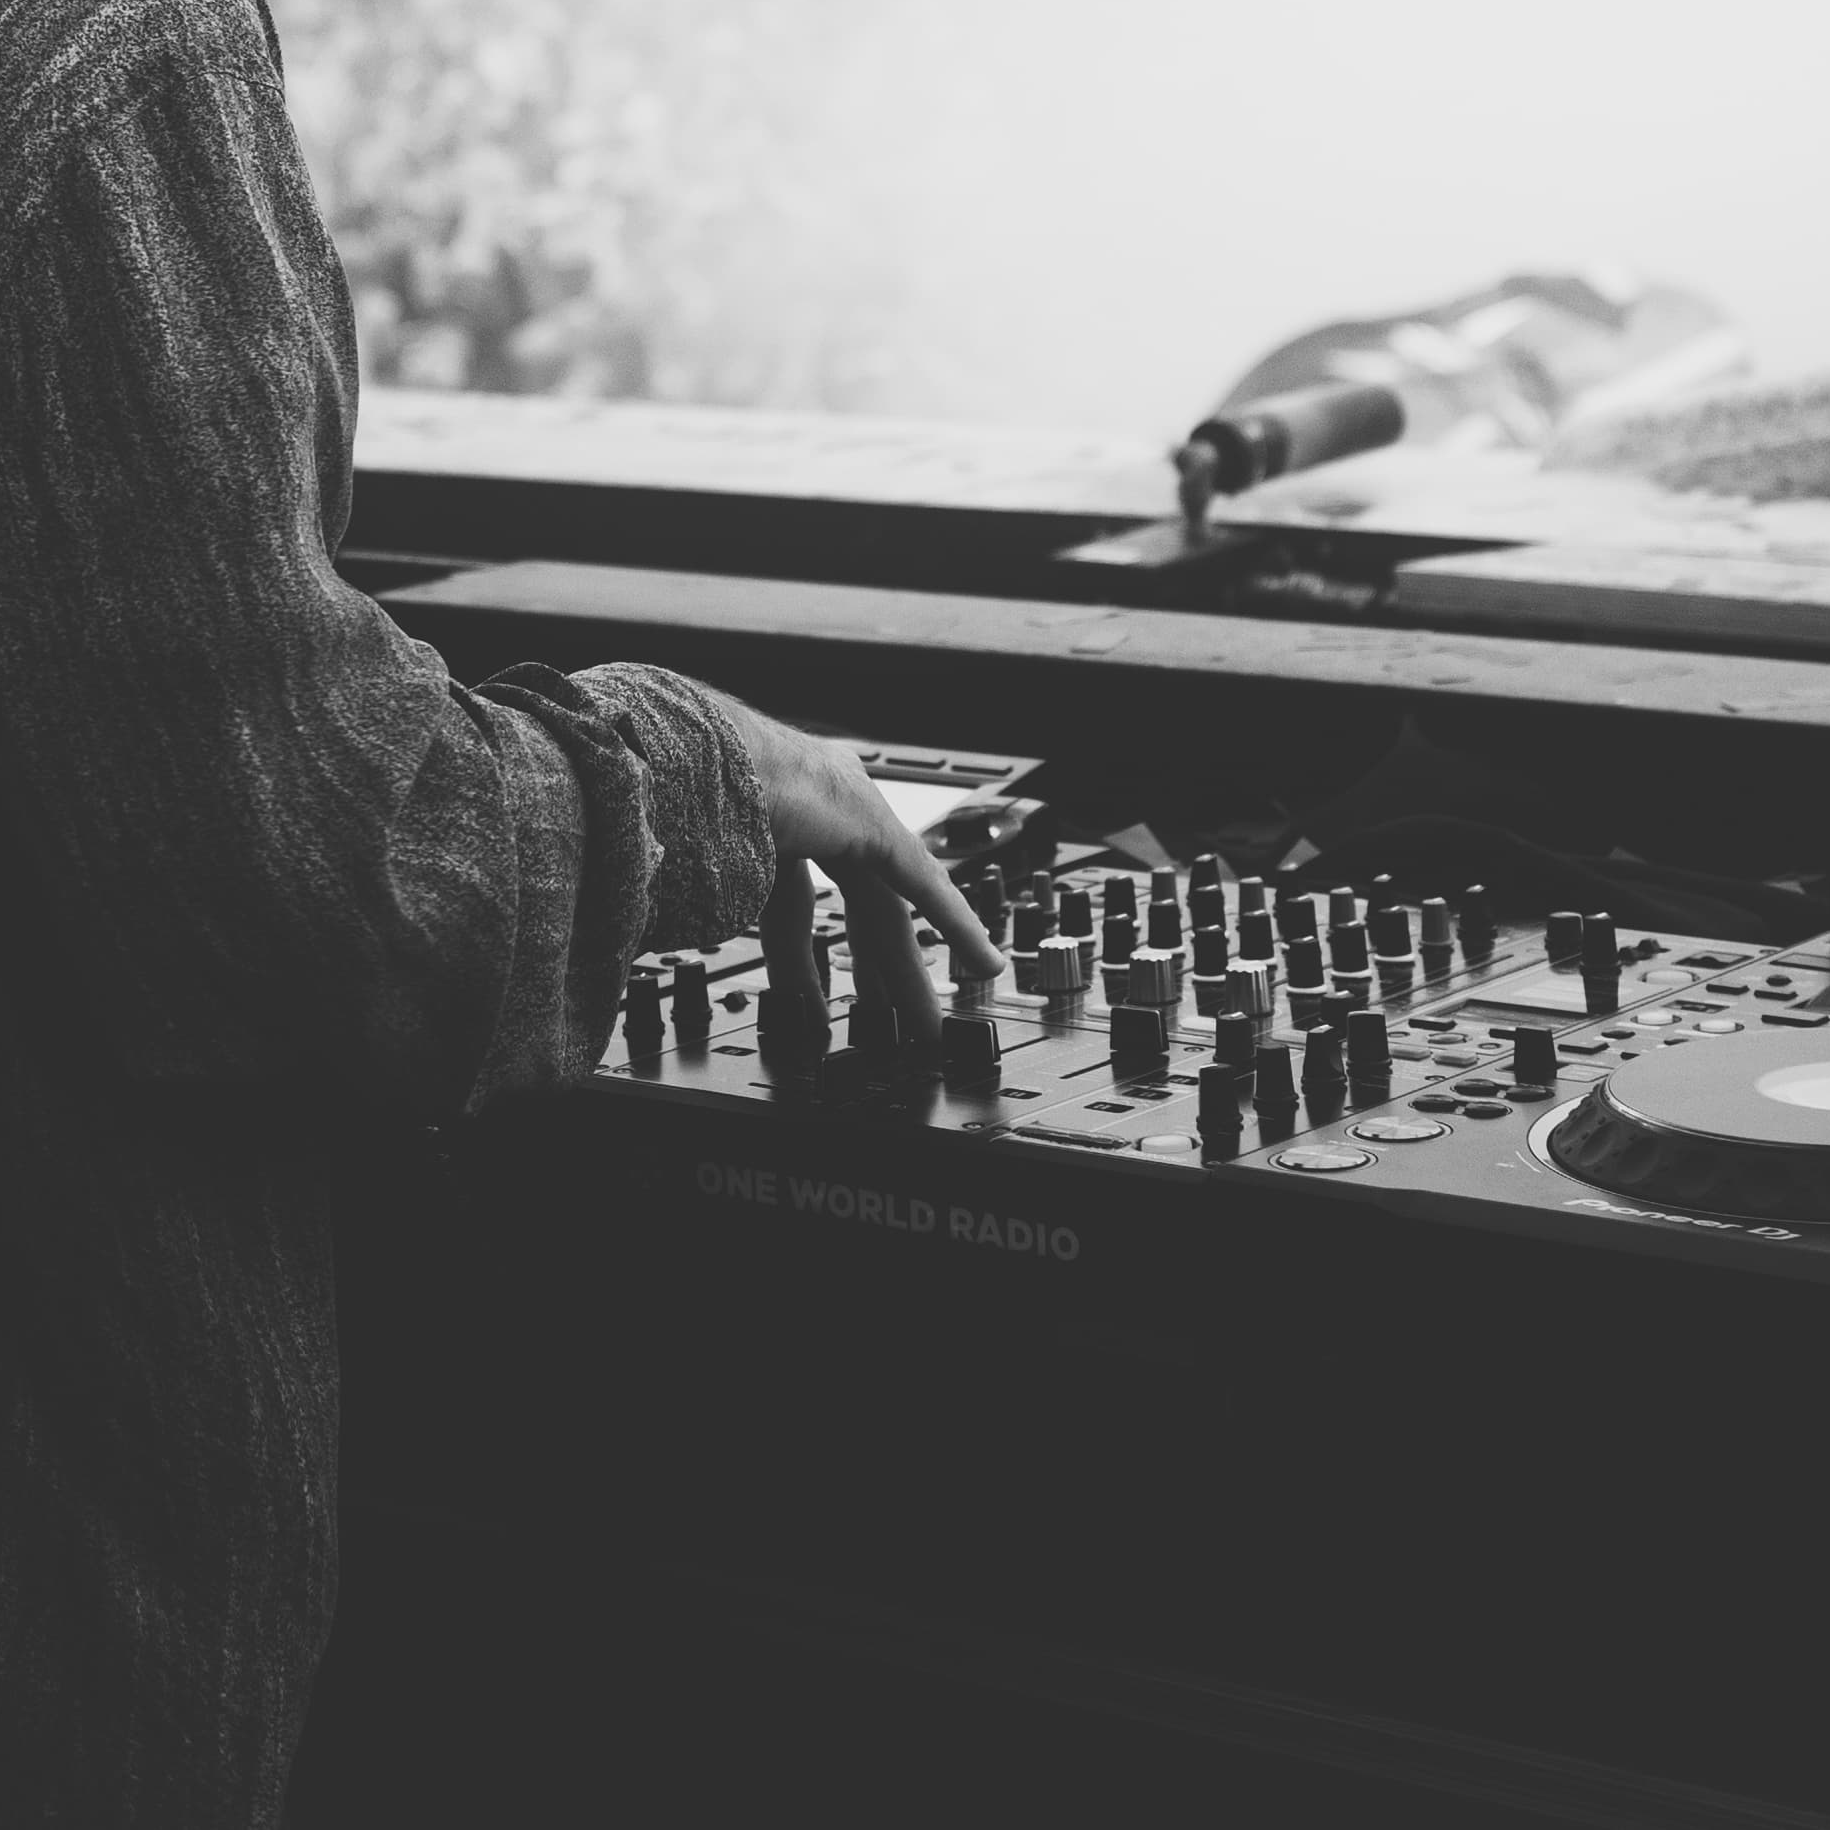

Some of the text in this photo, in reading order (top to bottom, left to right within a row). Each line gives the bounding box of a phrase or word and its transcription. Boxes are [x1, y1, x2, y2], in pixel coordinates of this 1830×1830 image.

[696, 1160, 1081, 1261] ONE WORLD RADIO
[1563, 1199, 1802, 1240] Pioneer DJ
